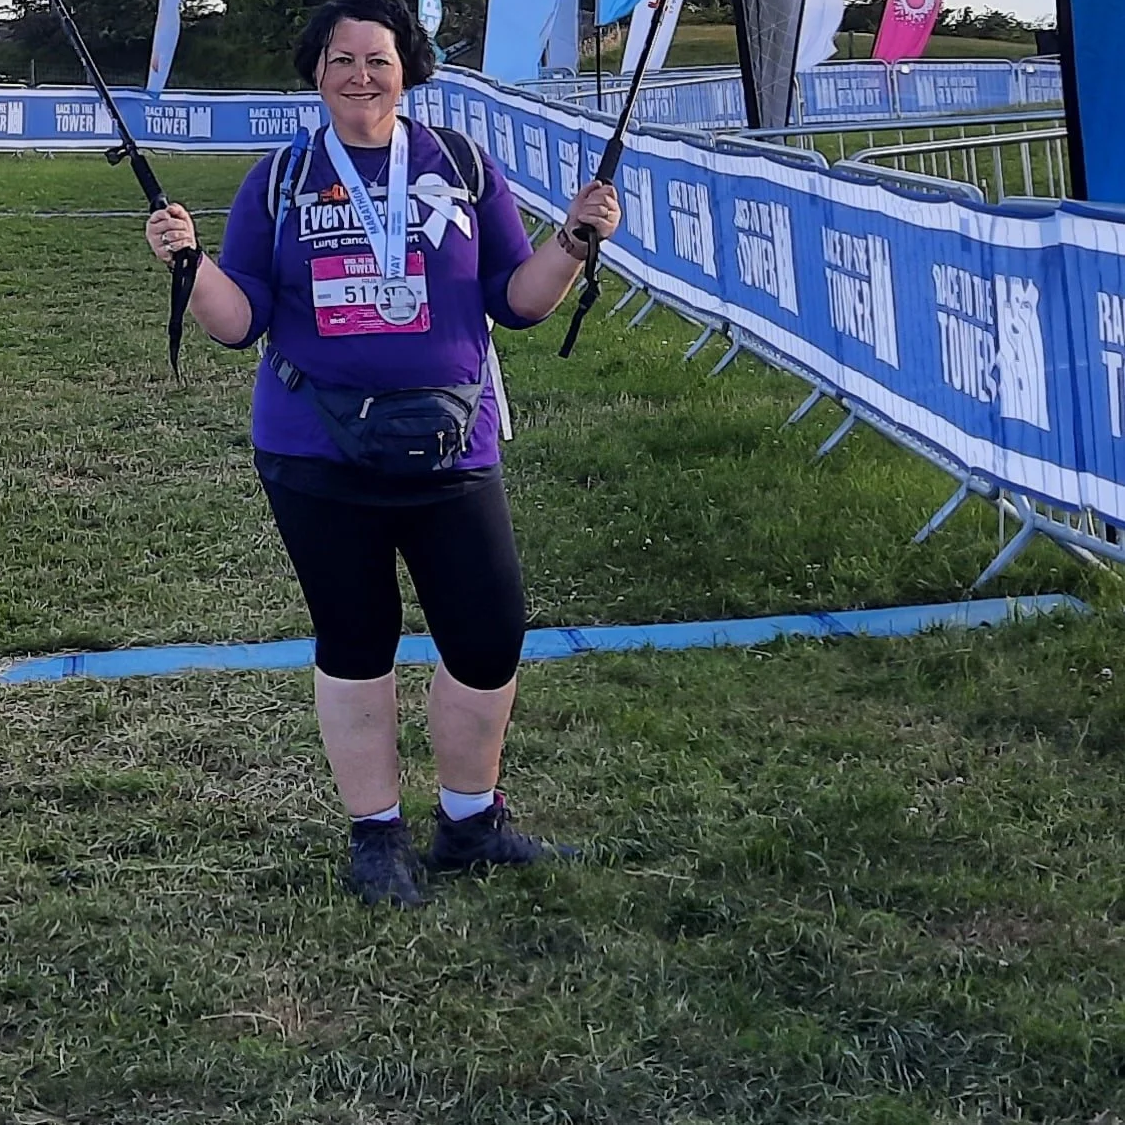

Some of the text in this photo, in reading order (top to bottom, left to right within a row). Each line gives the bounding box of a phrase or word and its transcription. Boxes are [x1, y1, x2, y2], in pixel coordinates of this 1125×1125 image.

[71, 104, 80, 114] TO
[165, 107, 174, 117] TO
[271, 108, 281, 118] TO
[55, 114, 93, 132] TOWER
[146, 117, 188, 135] TOWER
[250, 118, 298, 135] TOWER
[313, 235, 370, 250] Lung canc
[937, 311, 997, 404] TOWER
